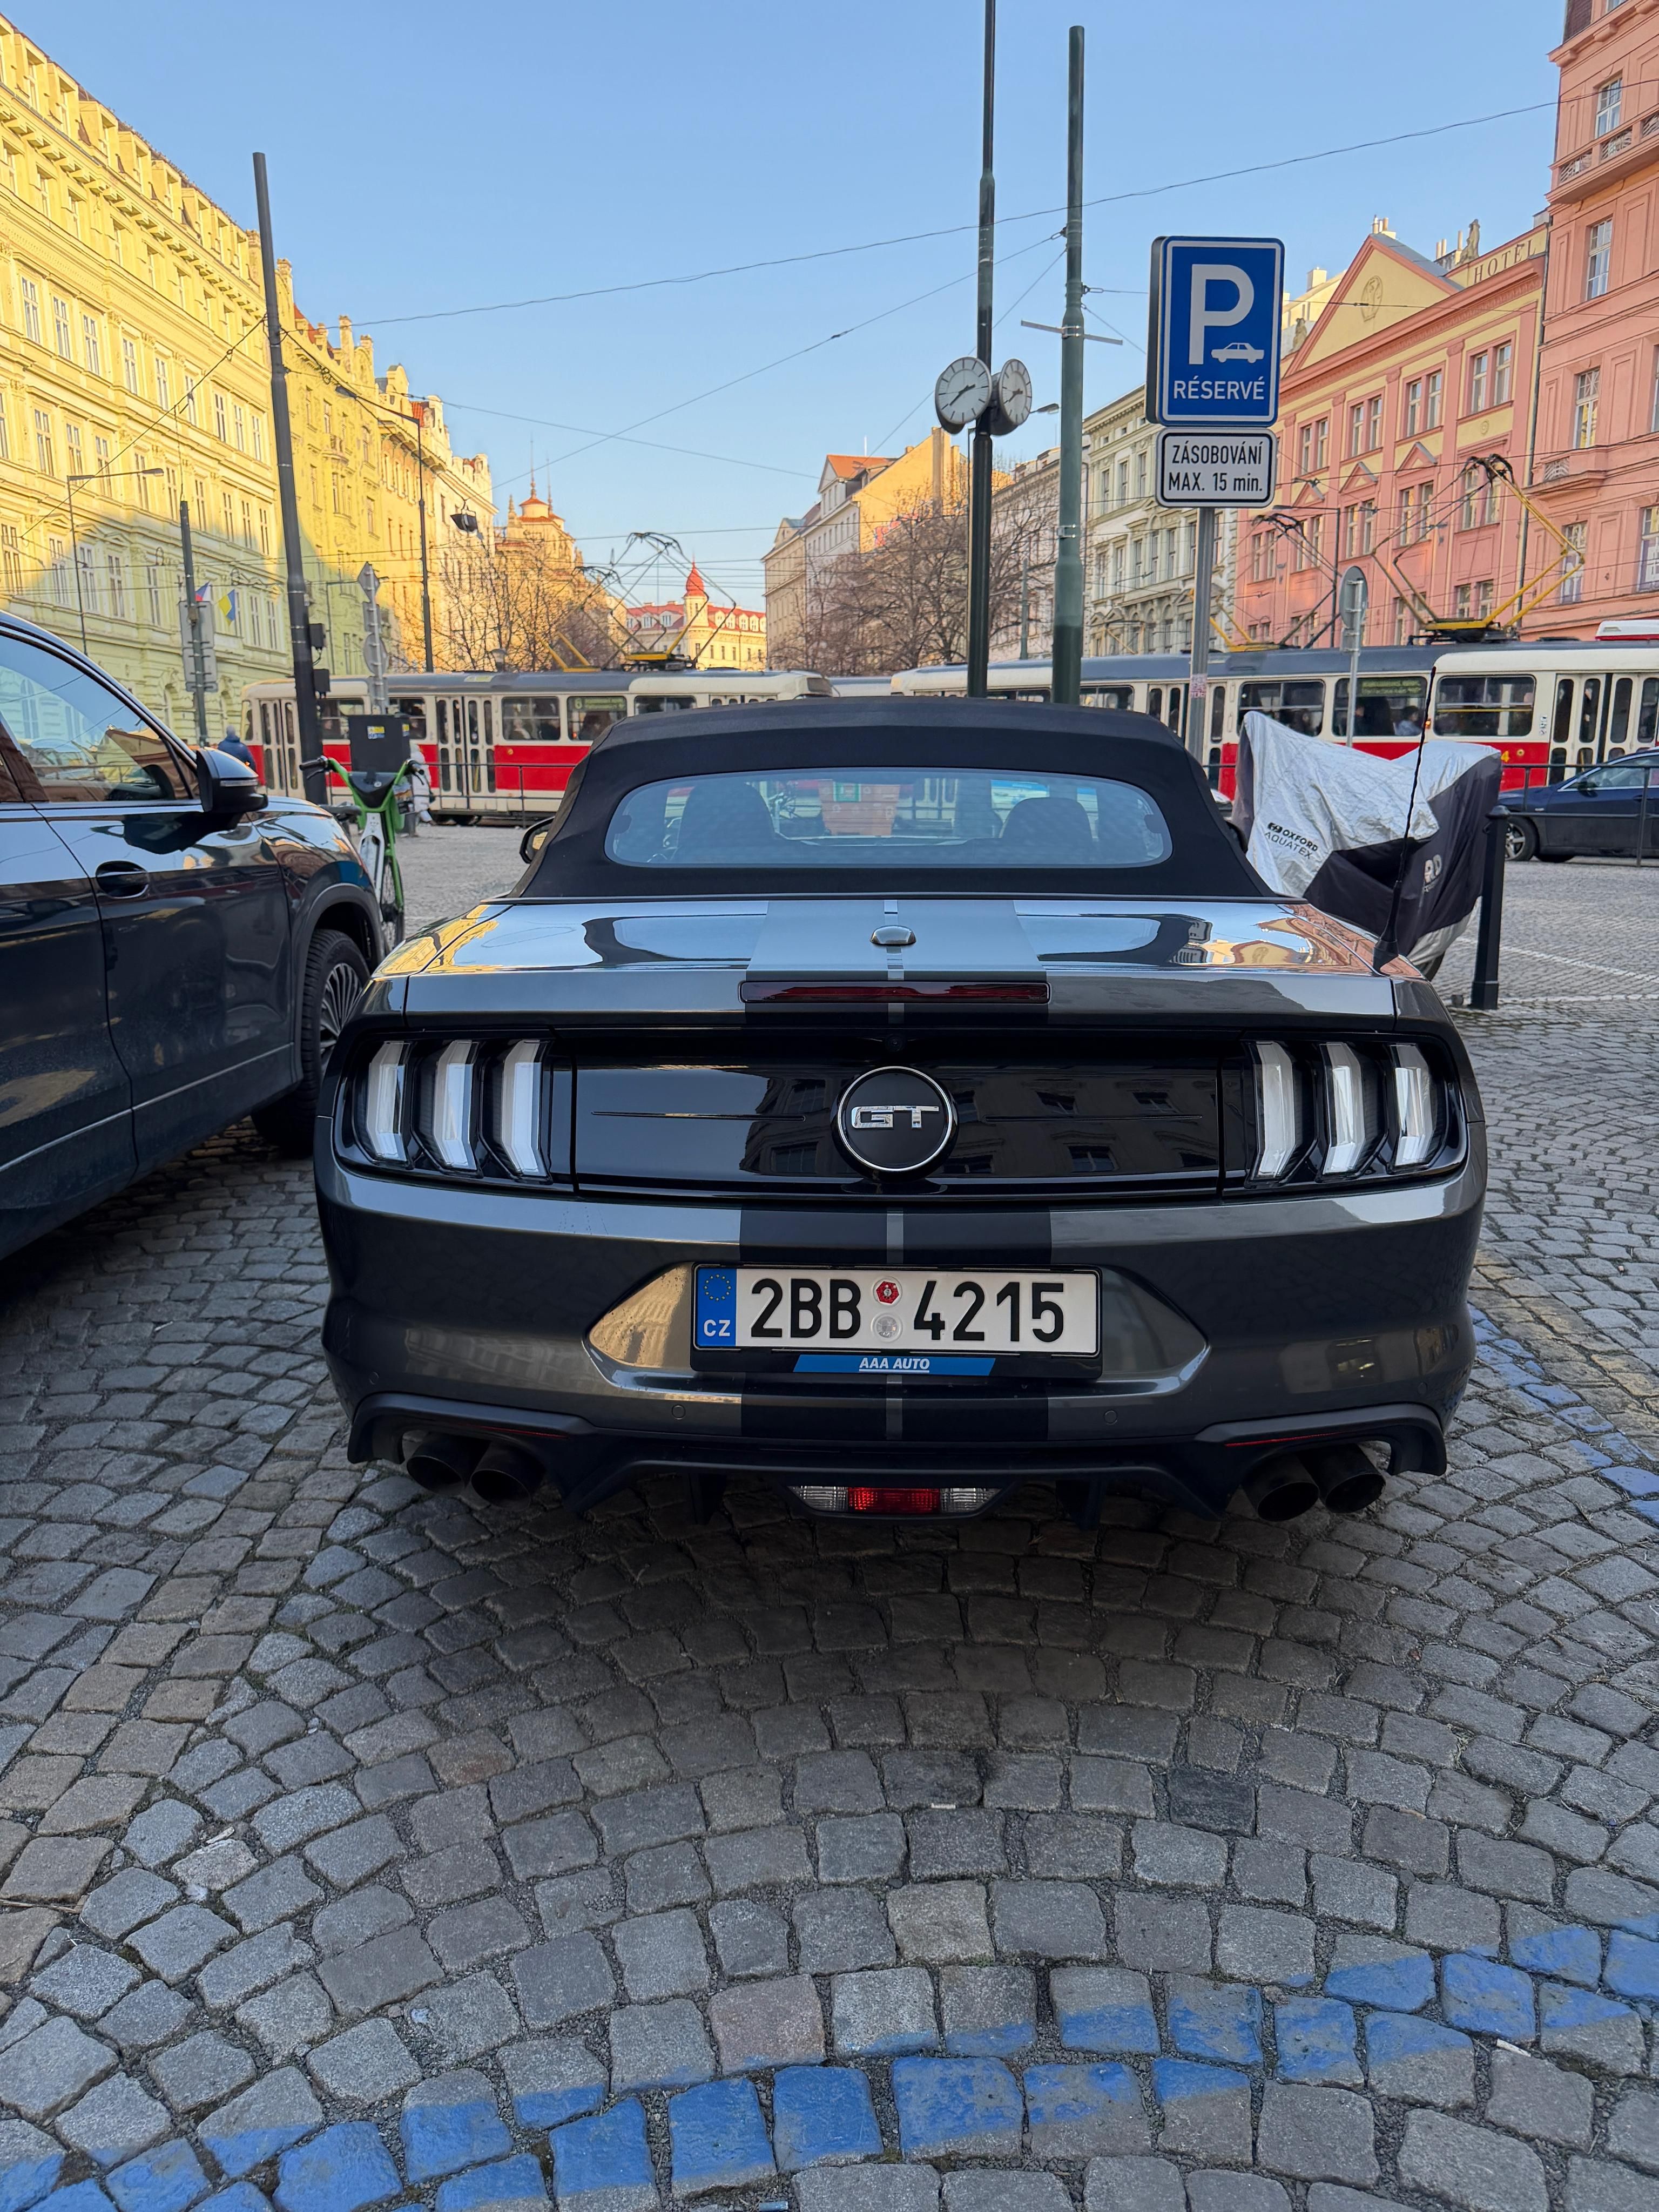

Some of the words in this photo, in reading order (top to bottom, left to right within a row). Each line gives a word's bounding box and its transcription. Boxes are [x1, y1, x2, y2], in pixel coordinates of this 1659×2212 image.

[1474, 239, 1536, 284] HOTEL
[1189, 264, 1255, 365] P
[1174, 375, 1265, 400] RÉSERVÉ
[1172, 440, 1263, 464] ZÁSOBOVÁNÍ
[1169, 472, 1205, 491] MAX.
[1212, 473, 1228, 491] 15
[1233, 473, 1263, 491] min.
[1264, 832, 1313, 859] AQUATEX
[1283, 829, 1318, 851] OXFORD
[851, 1105, 940, 1129] GT
[750, 1278, 861, 1339] 2BB
[913, 1280, 1064, 1343] 4215
[703, 1319, 731, 1337] CZ
[859, 1357, 889, 1368] AAA
[893, 1358, 930, 1370] AUTO
